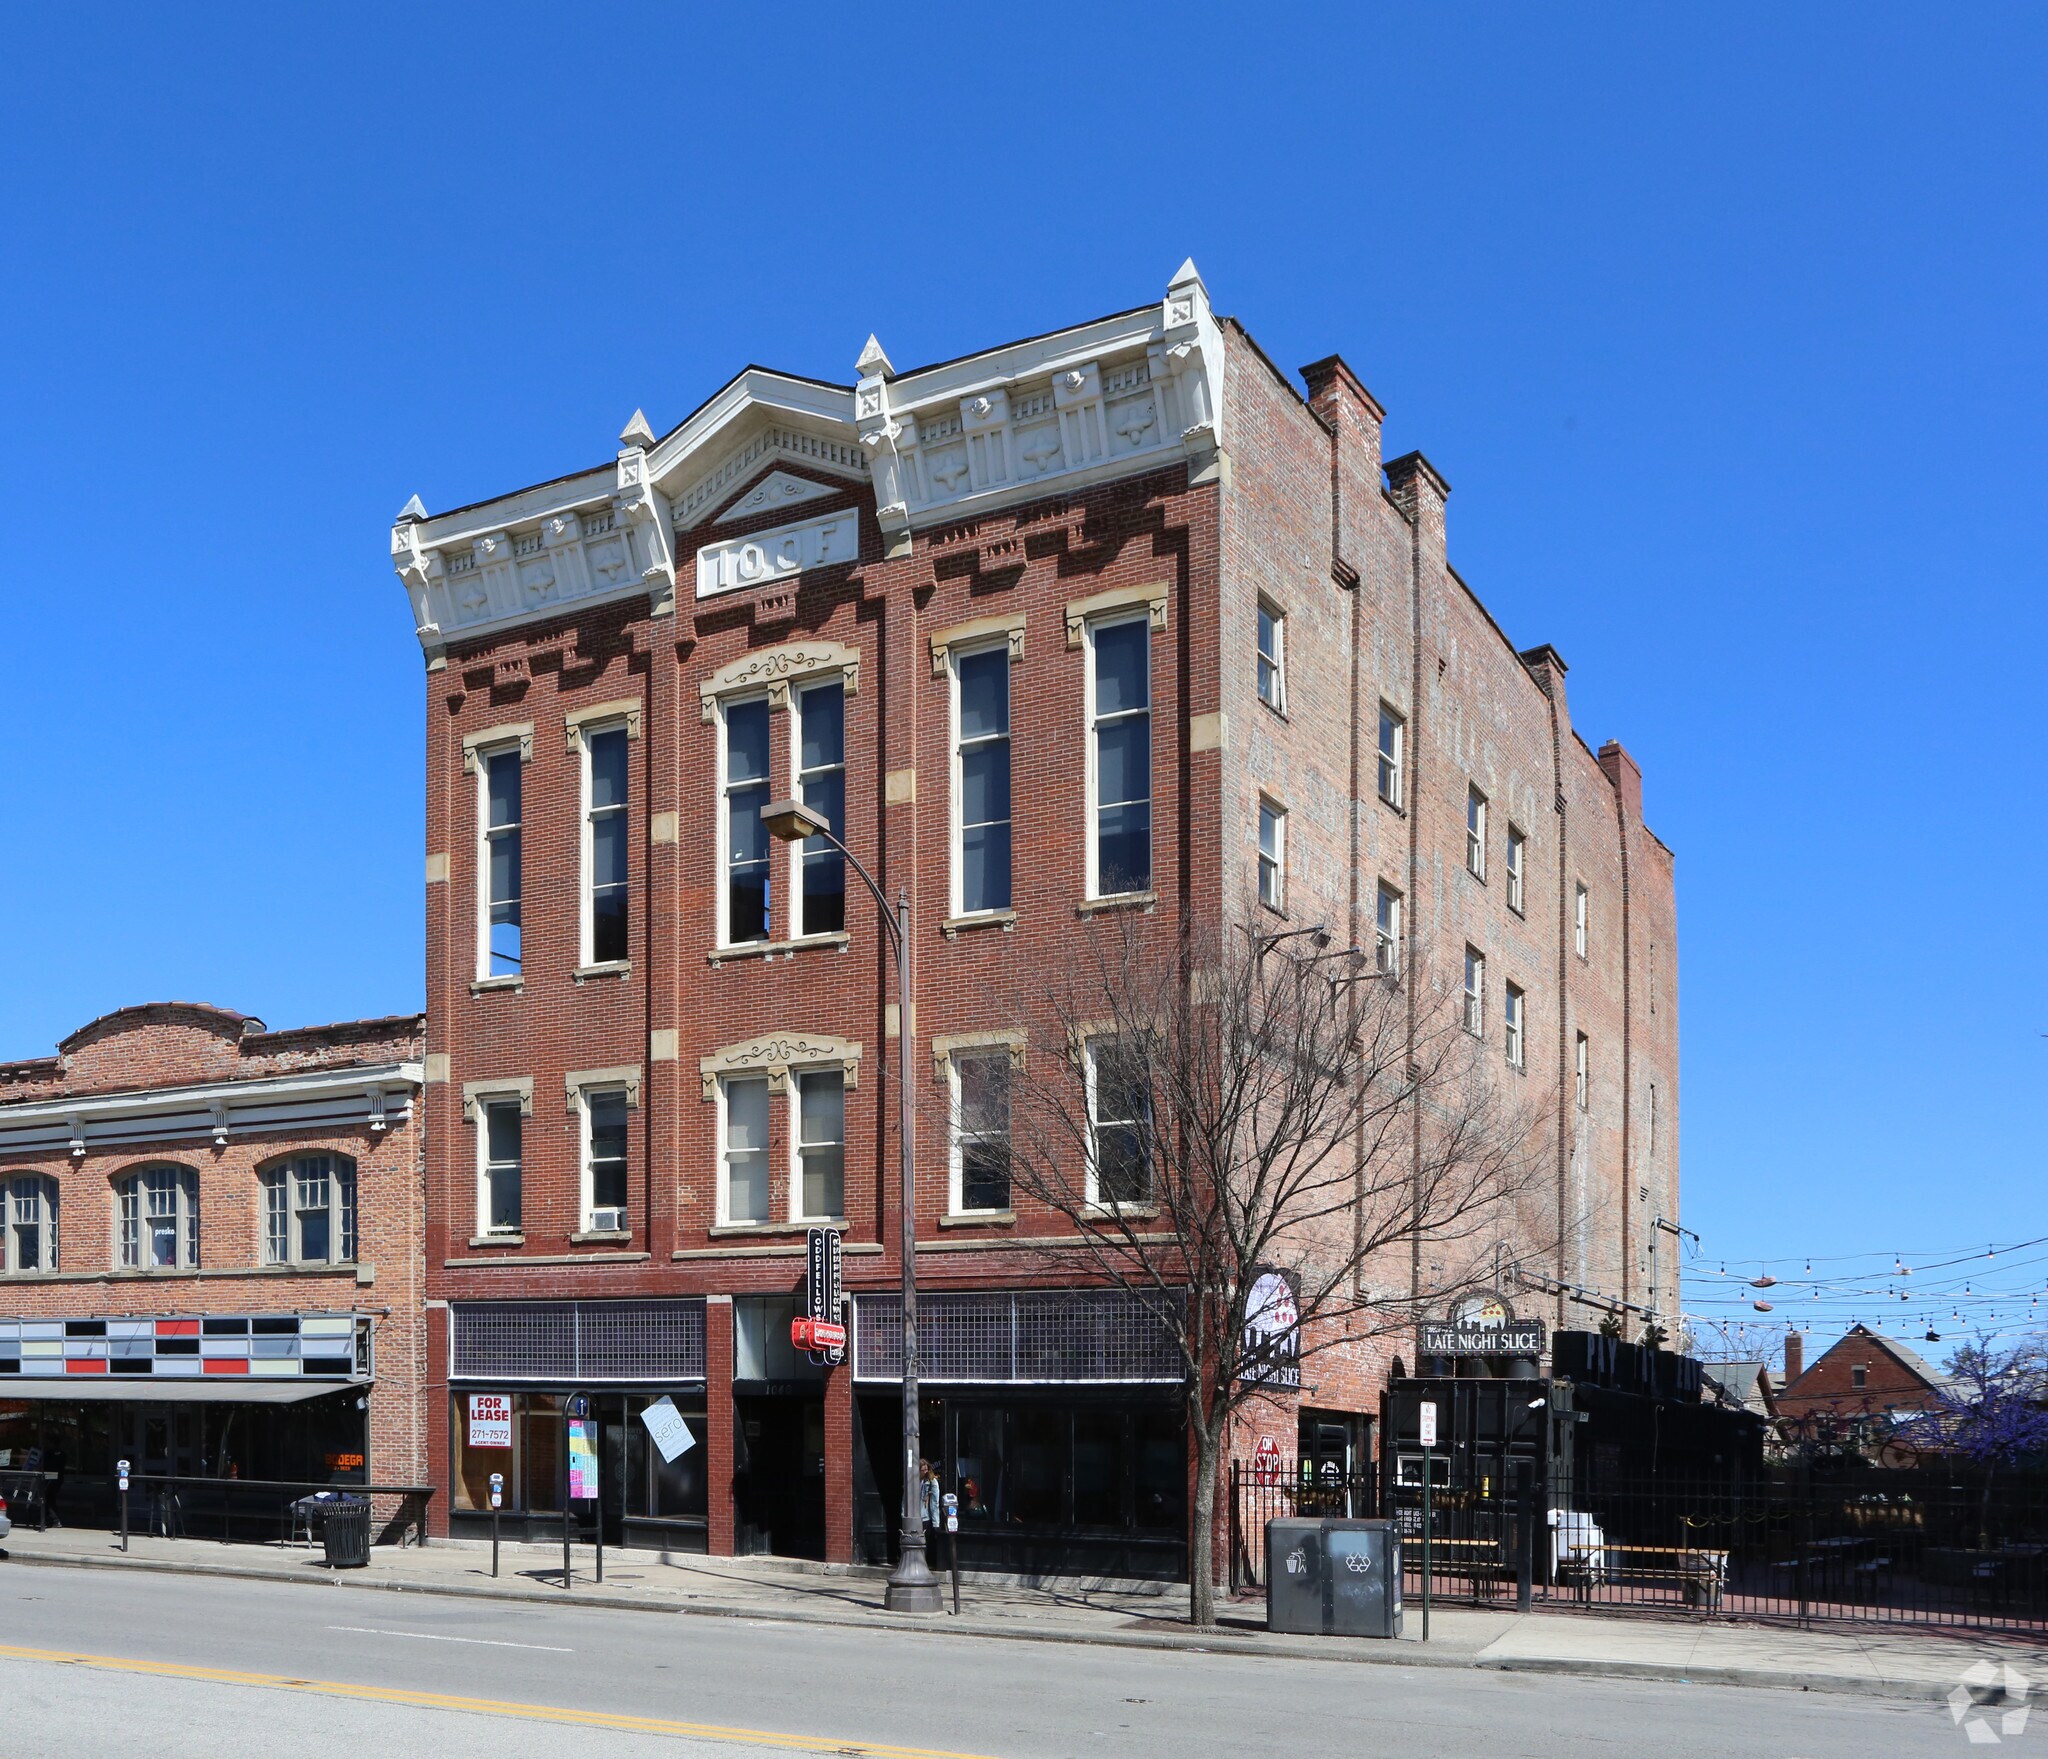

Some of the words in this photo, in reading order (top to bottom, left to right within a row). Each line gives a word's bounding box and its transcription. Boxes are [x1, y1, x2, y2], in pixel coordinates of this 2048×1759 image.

[154, 1226, 176, 1238] presko
[814, 1237, 823, 1321] ODDFELLOWS
[1427, 1333, 1455, 1349] LATE
[1458, 1333, 1497, 1349] NIGHT
[1501, 1333, 1537, 1349] SLICE
[1280, 1366, 1300, 1386] SLICE
[477, 1397, 502, 1409] FOR
[471, 1409, 509, 1421] LEASE
[471, 1429, 509, 1439] 271-7572
[654, 1418, 682, 1443] sero
[1262, 1437, 1273, 1451] OH
[325, 1453, 364, 1466] BODEGA
[1256, 1453, 1279, 1472] STOP
